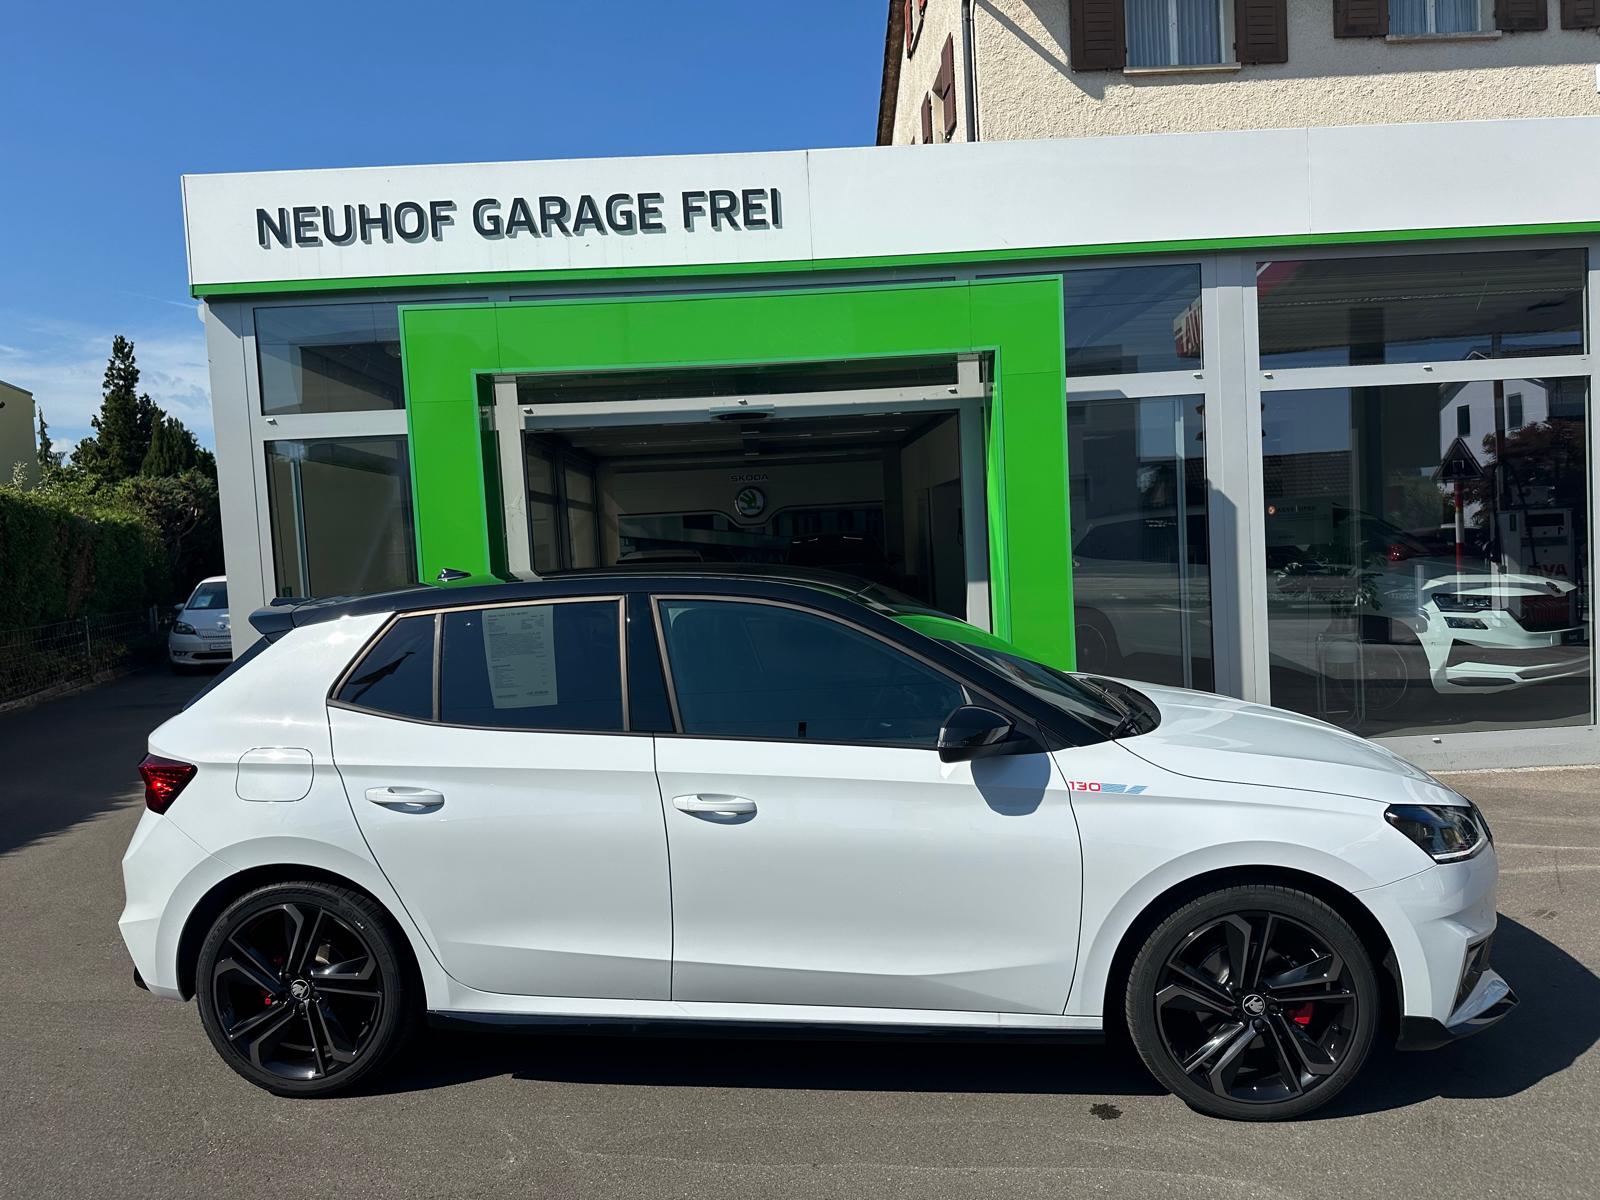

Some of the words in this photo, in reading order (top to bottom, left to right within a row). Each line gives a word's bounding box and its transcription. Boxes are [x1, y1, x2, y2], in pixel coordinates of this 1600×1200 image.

[256, 200, 457, 249] NEUHOF
[472, 192, 667, 240] GARAGE
[682, 188, 783, 232] FREI
[1069, 781, 1101, 792] 130
